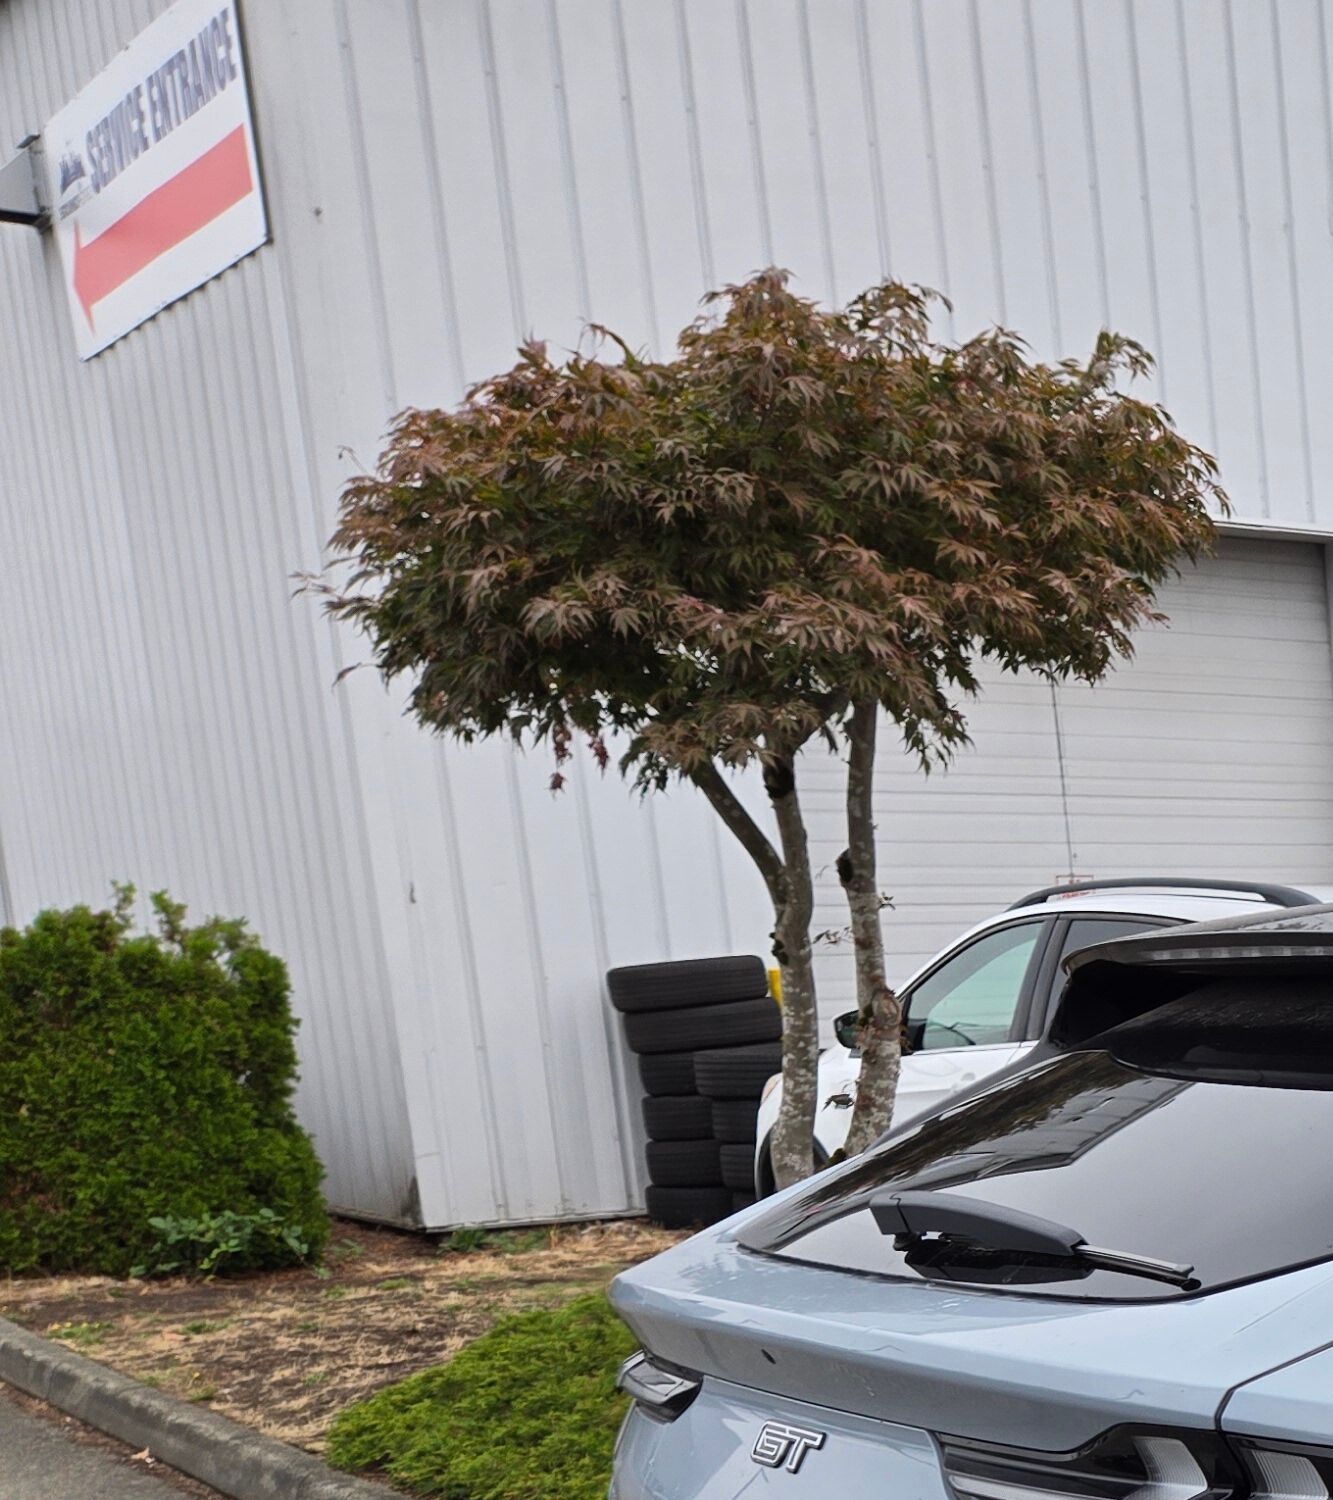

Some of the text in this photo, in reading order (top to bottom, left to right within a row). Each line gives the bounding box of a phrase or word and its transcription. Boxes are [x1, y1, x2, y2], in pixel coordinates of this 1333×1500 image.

[85, 7, 237, 194] SERVICE ENTRANCE
[751, 1420, 827, 1474] GT
